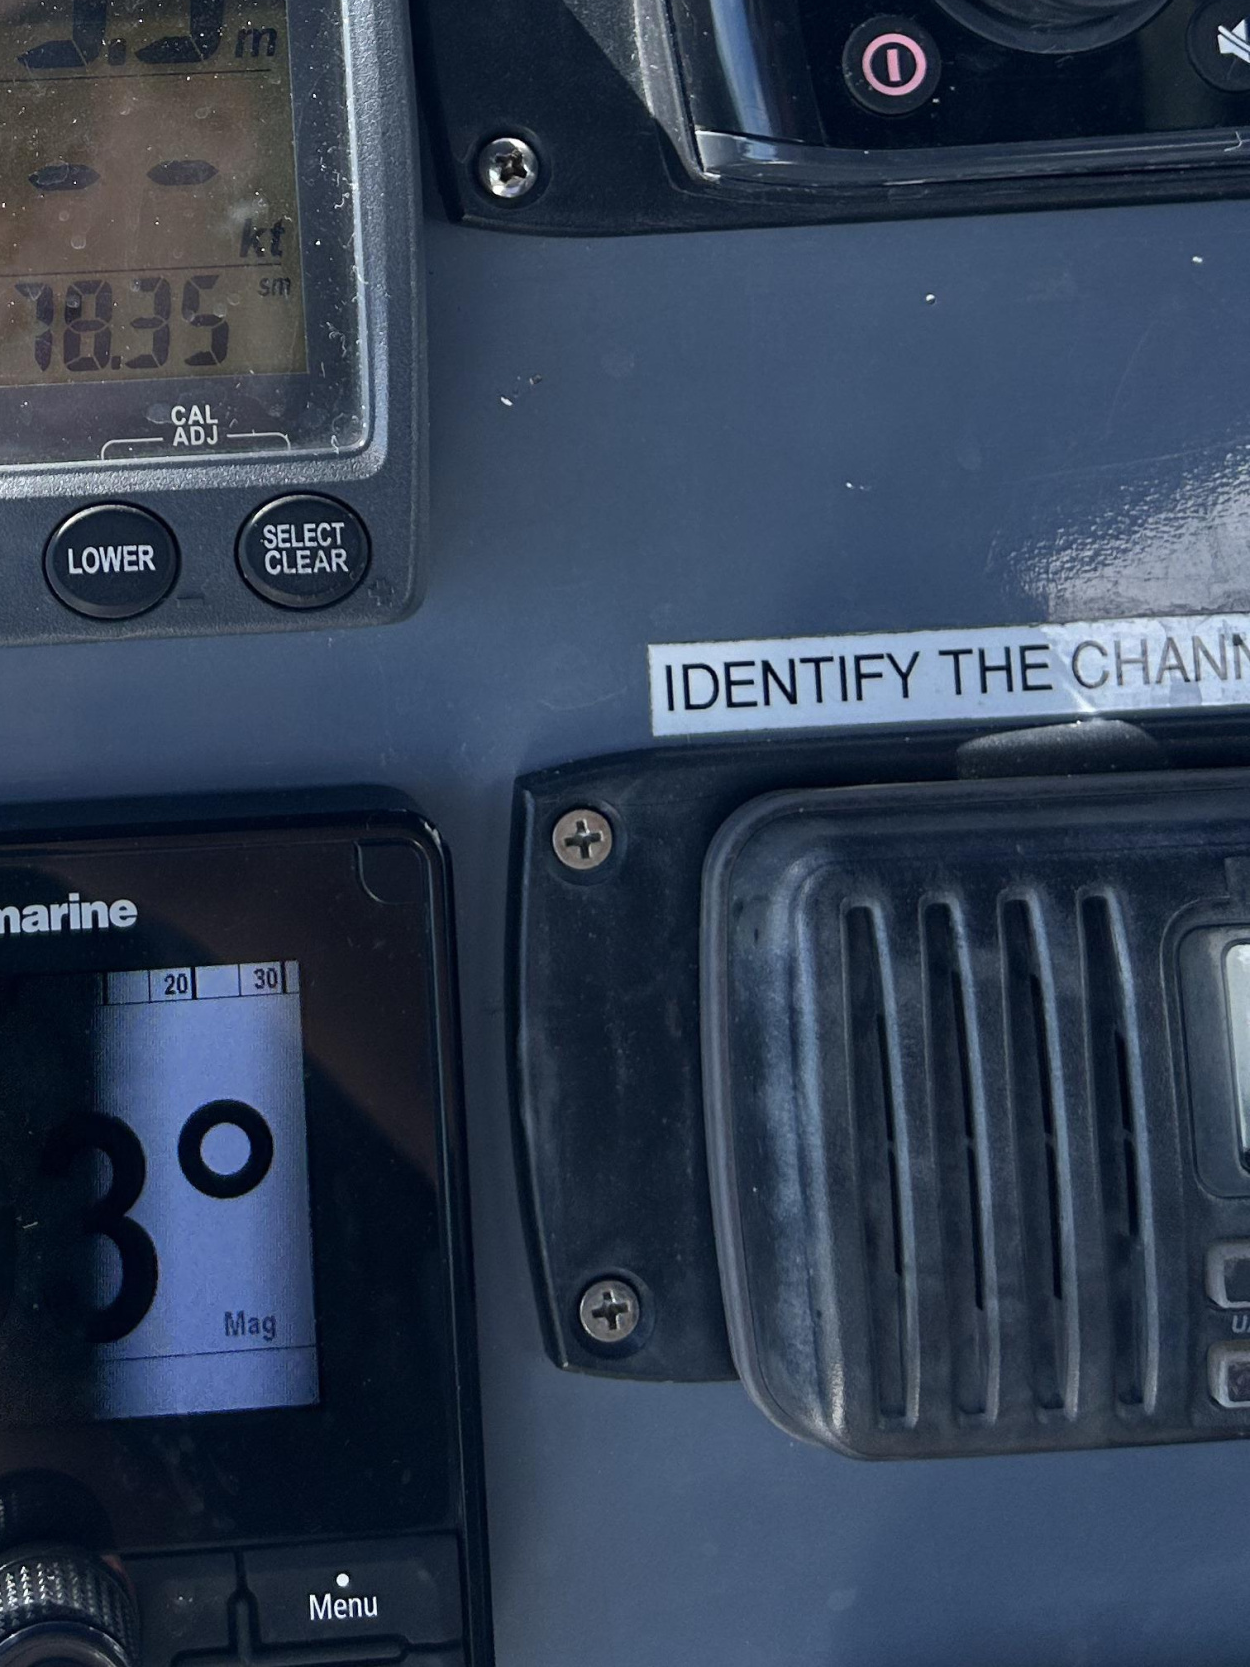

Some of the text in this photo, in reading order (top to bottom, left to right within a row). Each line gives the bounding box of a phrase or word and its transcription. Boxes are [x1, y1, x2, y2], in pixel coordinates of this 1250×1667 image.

[234, 27, 278, 59] m
[239, 218, 286, 258] kt
[257, 277, 291, 297] sm
[170, 406, 219, 425] CAL
[173, 426, 219, 447] ADJ
[262, 521, 345, 549] SELECT
[66, 544, 156, 576] LOWER
[264, 547, 349, 576] CLEAR
[664, 652, 921, 712] IDENTIFY
[938, 643, 1054, 697] THE
[164, 967, 278, 996] 20 30
[224, 1310, 277, 1338] Mag
[308, 1591, 379, 1622] Menu
